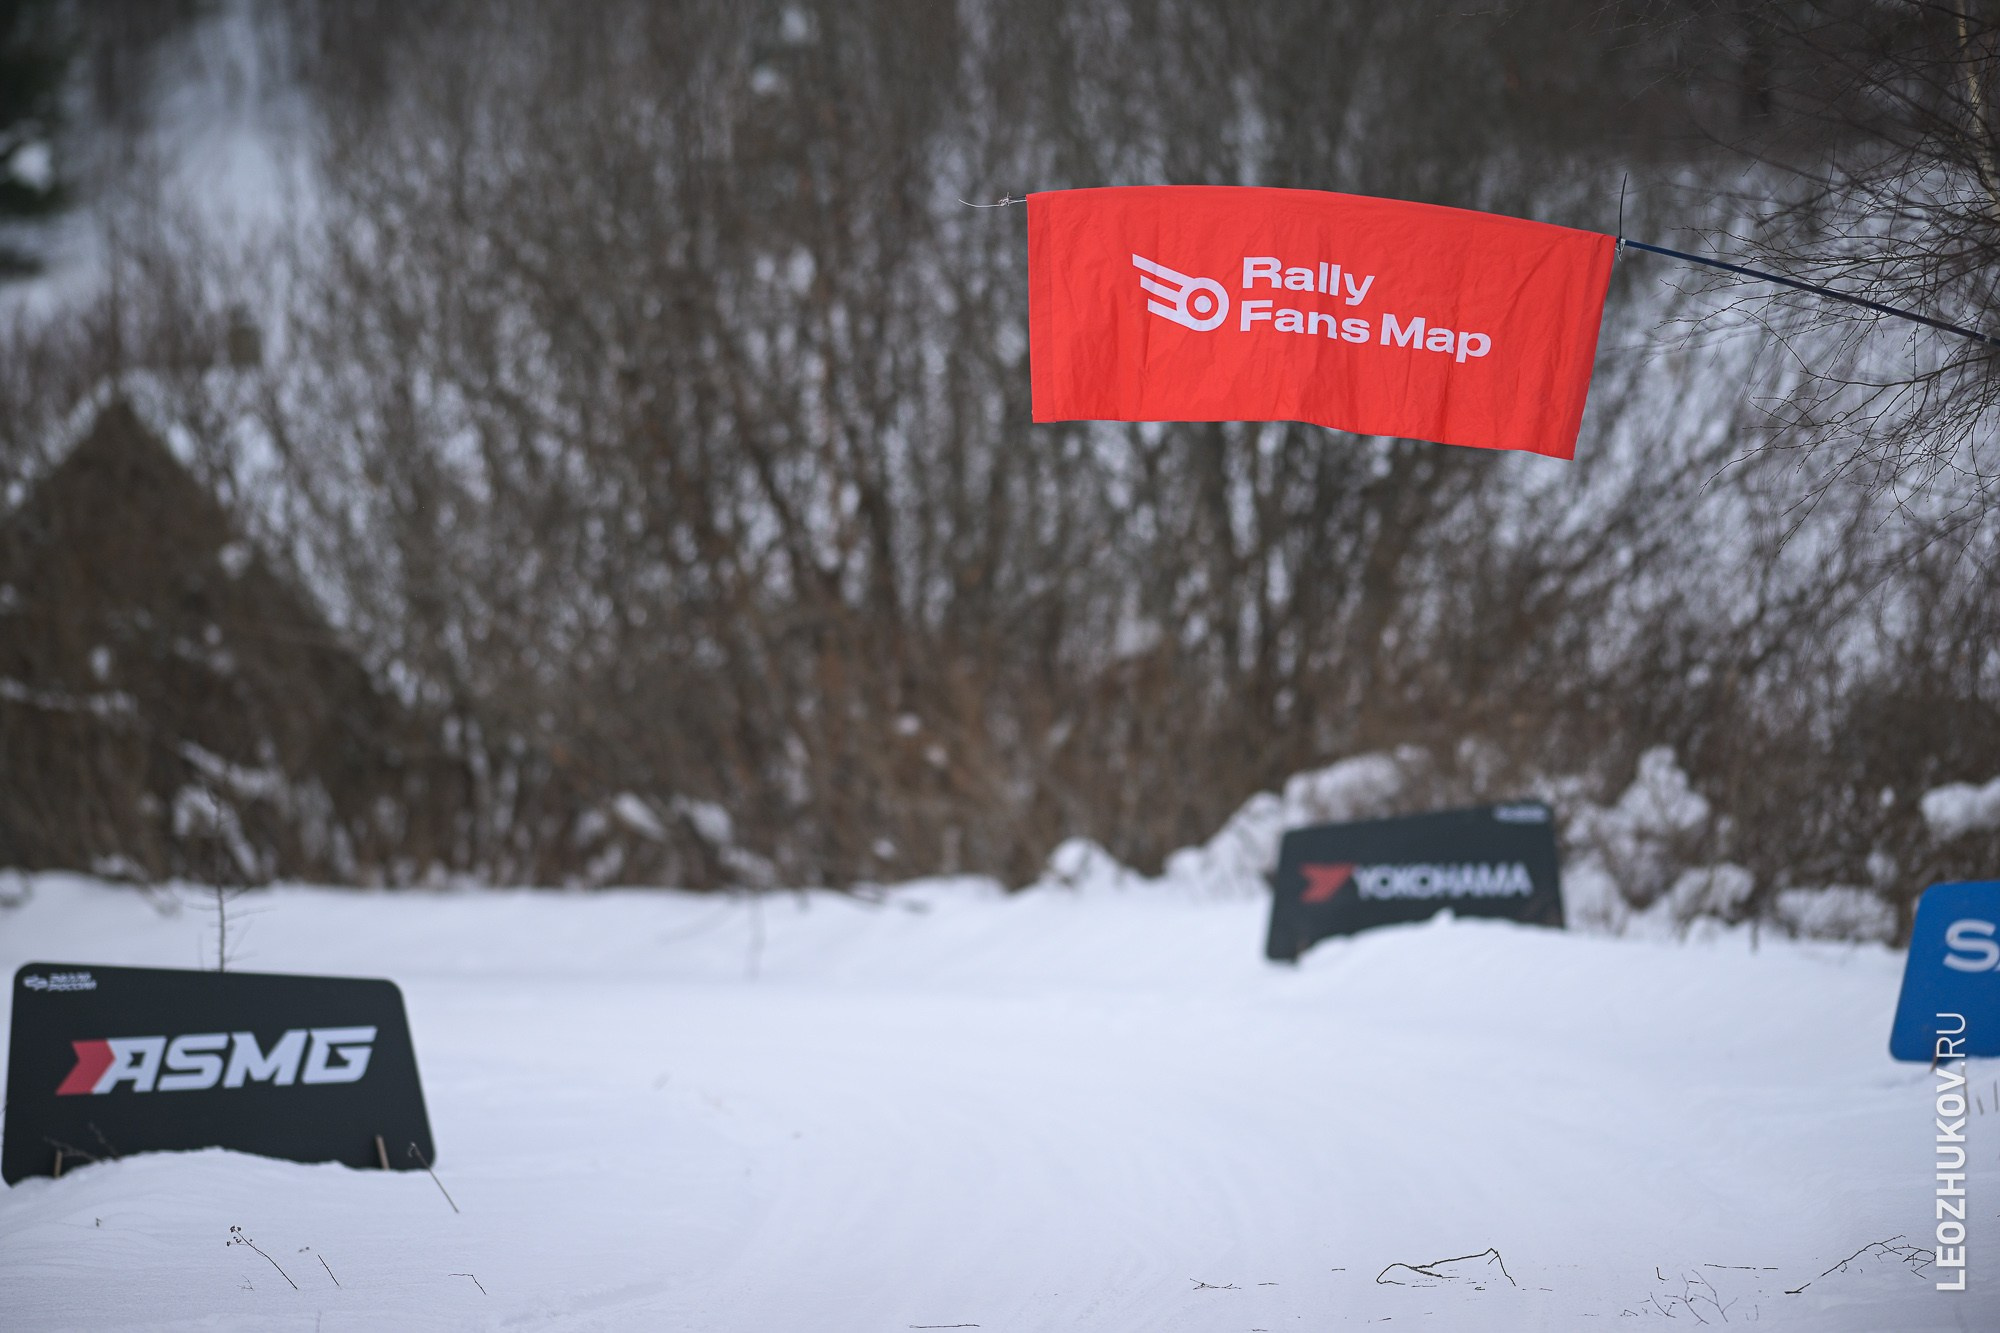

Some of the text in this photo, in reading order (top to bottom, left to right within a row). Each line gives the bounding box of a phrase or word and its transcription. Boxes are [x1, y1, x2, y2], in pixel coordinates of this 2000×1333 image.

[1242, 257, 1376, 305] Rally
[1240, 299, 1492, 363] Fans Map
[1352, 862, 1533, 899] YOKOHAMA
[1943, 919, 2000, 972] S
[90, 1026, 377, 1095] ASMG
